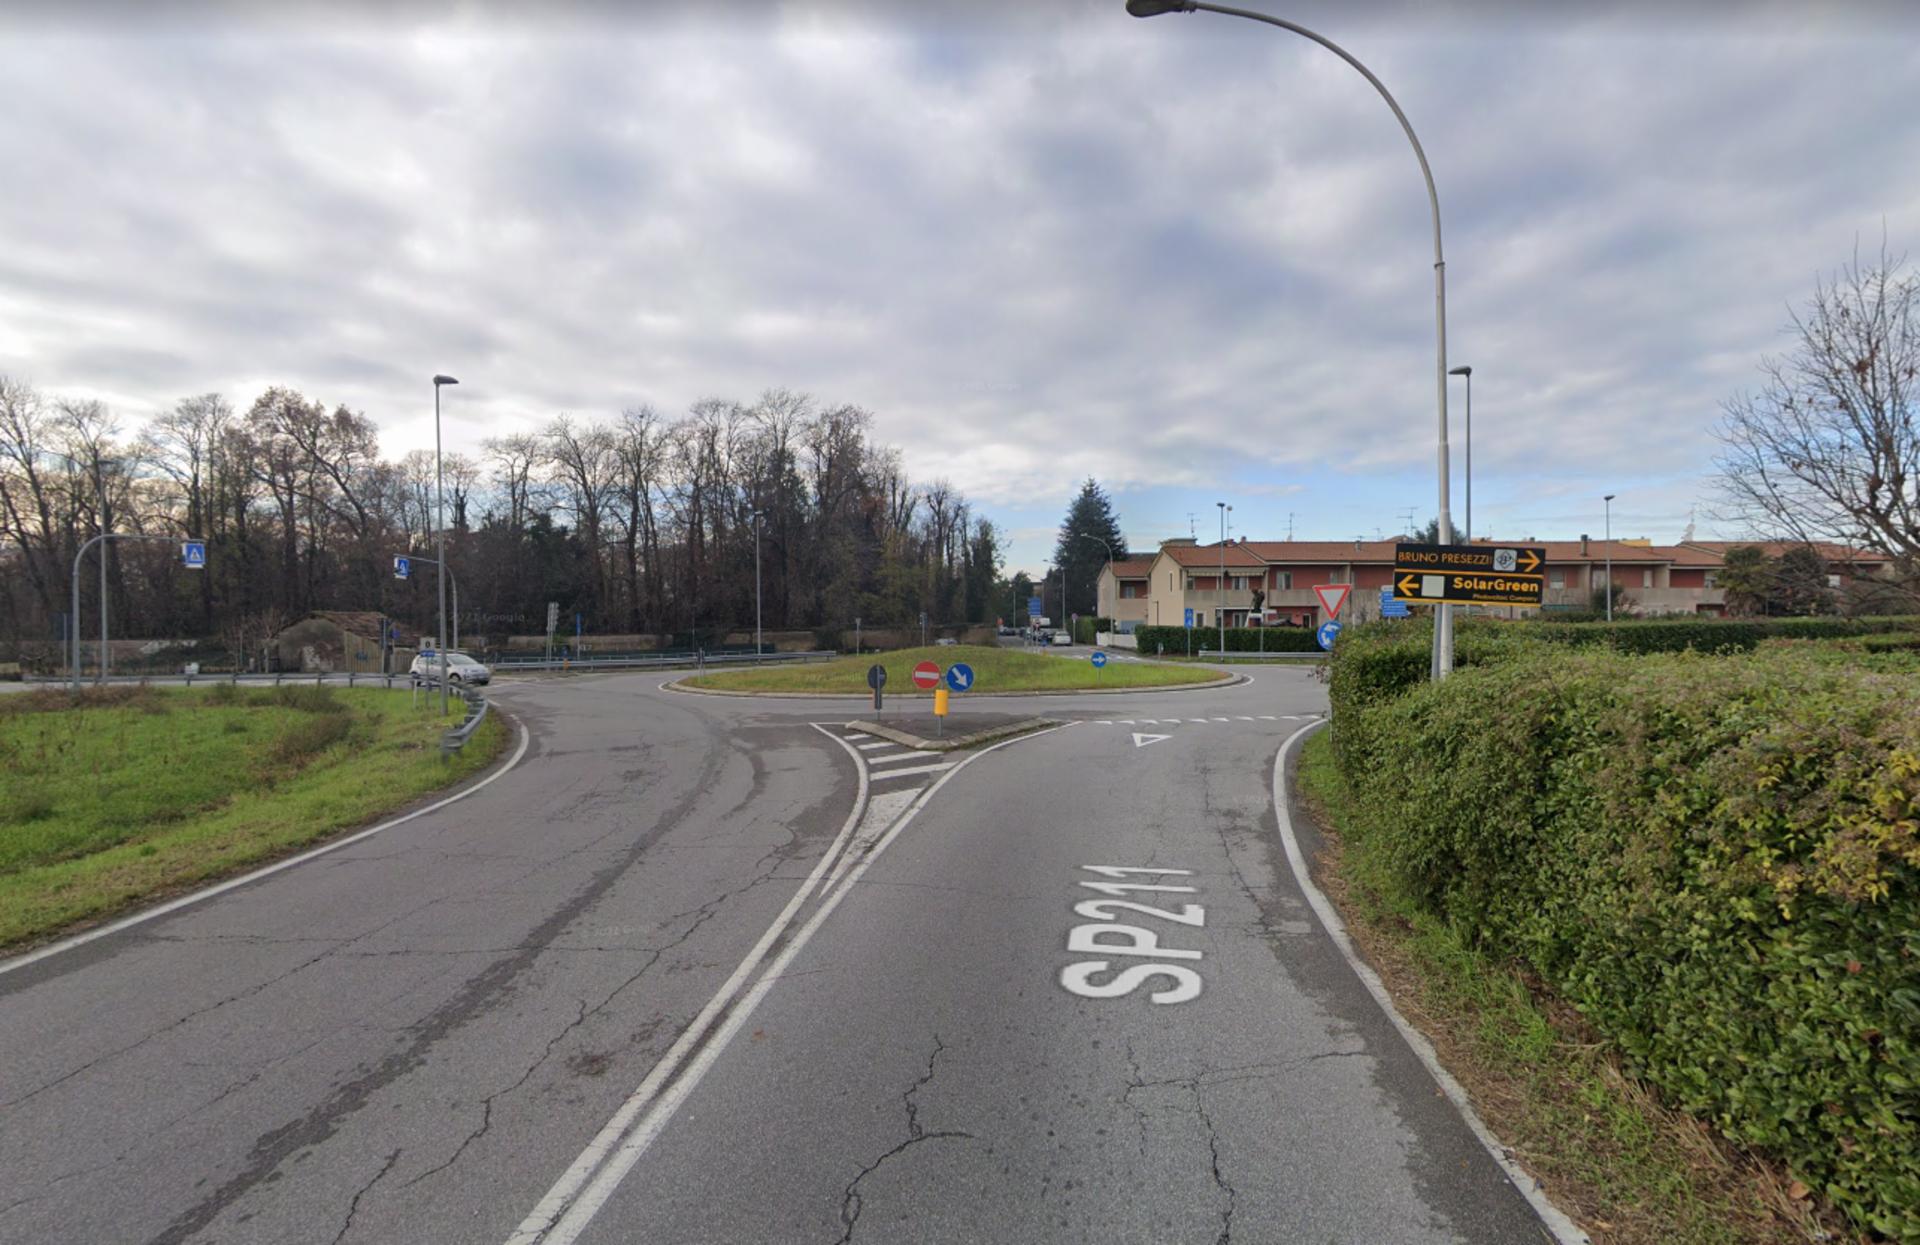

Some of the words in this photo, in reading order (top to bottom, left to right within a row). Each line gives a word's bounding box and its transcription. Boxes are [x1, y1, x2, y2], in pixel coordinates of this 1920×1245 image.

[1398, 552, 1439, 563] BRUNO
[1441, 553, 1489, 565] PRESEZZI
[1453, 577, 1539, 592] SolarGreen
[1061, 865, 1205, 1004] SP211
